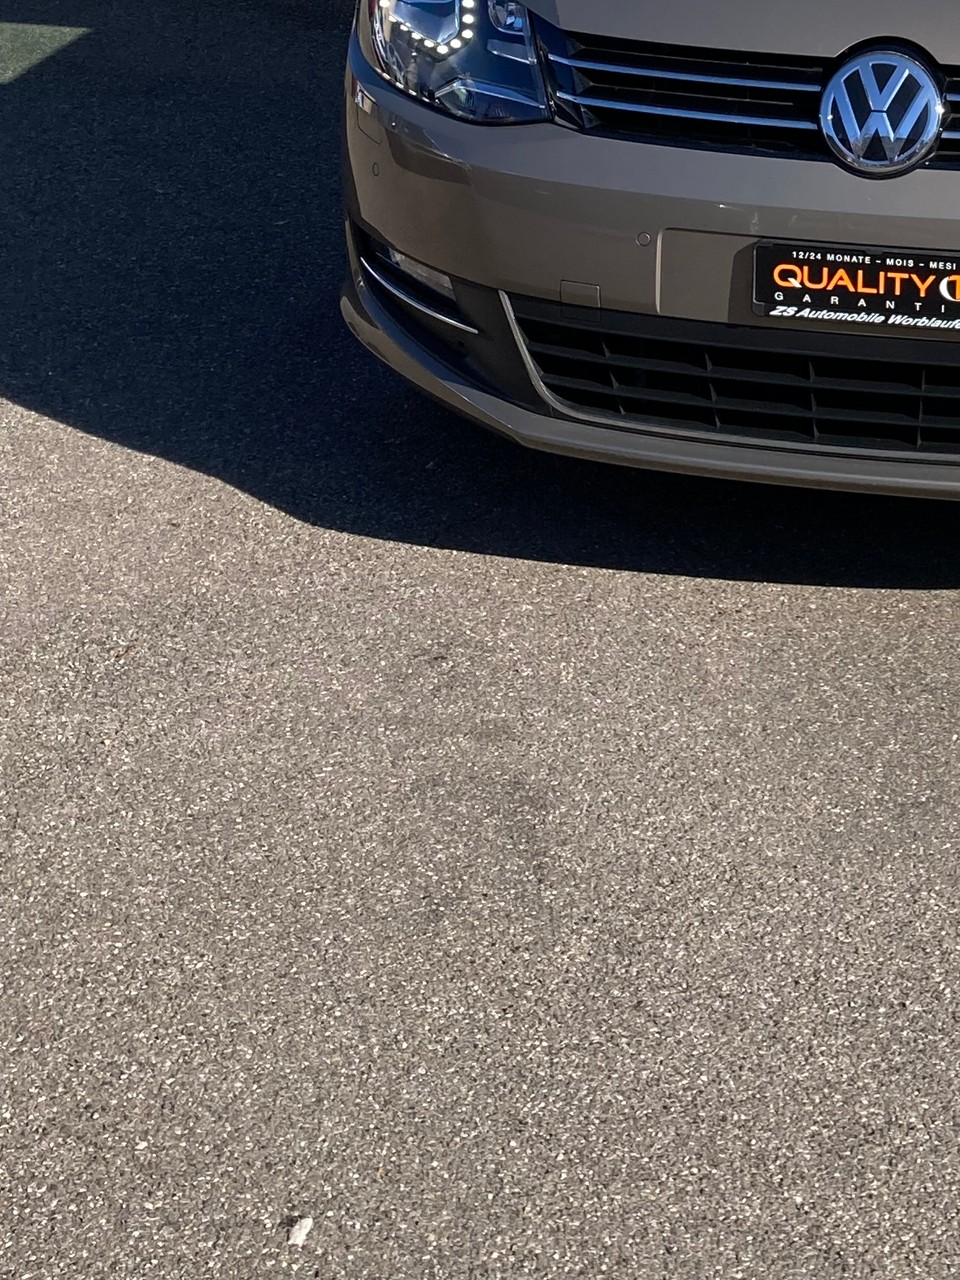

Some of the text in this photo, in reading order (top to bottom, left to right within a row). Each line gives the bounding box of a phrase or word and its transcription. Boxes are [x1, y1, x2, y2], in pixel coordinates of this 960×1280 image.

[820, 51, 942, 173] VW
[792, 251, 822, 260] 12/24
[827, 253, 871, 264] MONATE
[886, 258, 914, 267] MOIS
[929, 261, 956, 270] MESI
[773, 264, 936, 297] QUALITY
[769, 306, 798, 316] ZS
[795, 308, 886, 323] Automobile
